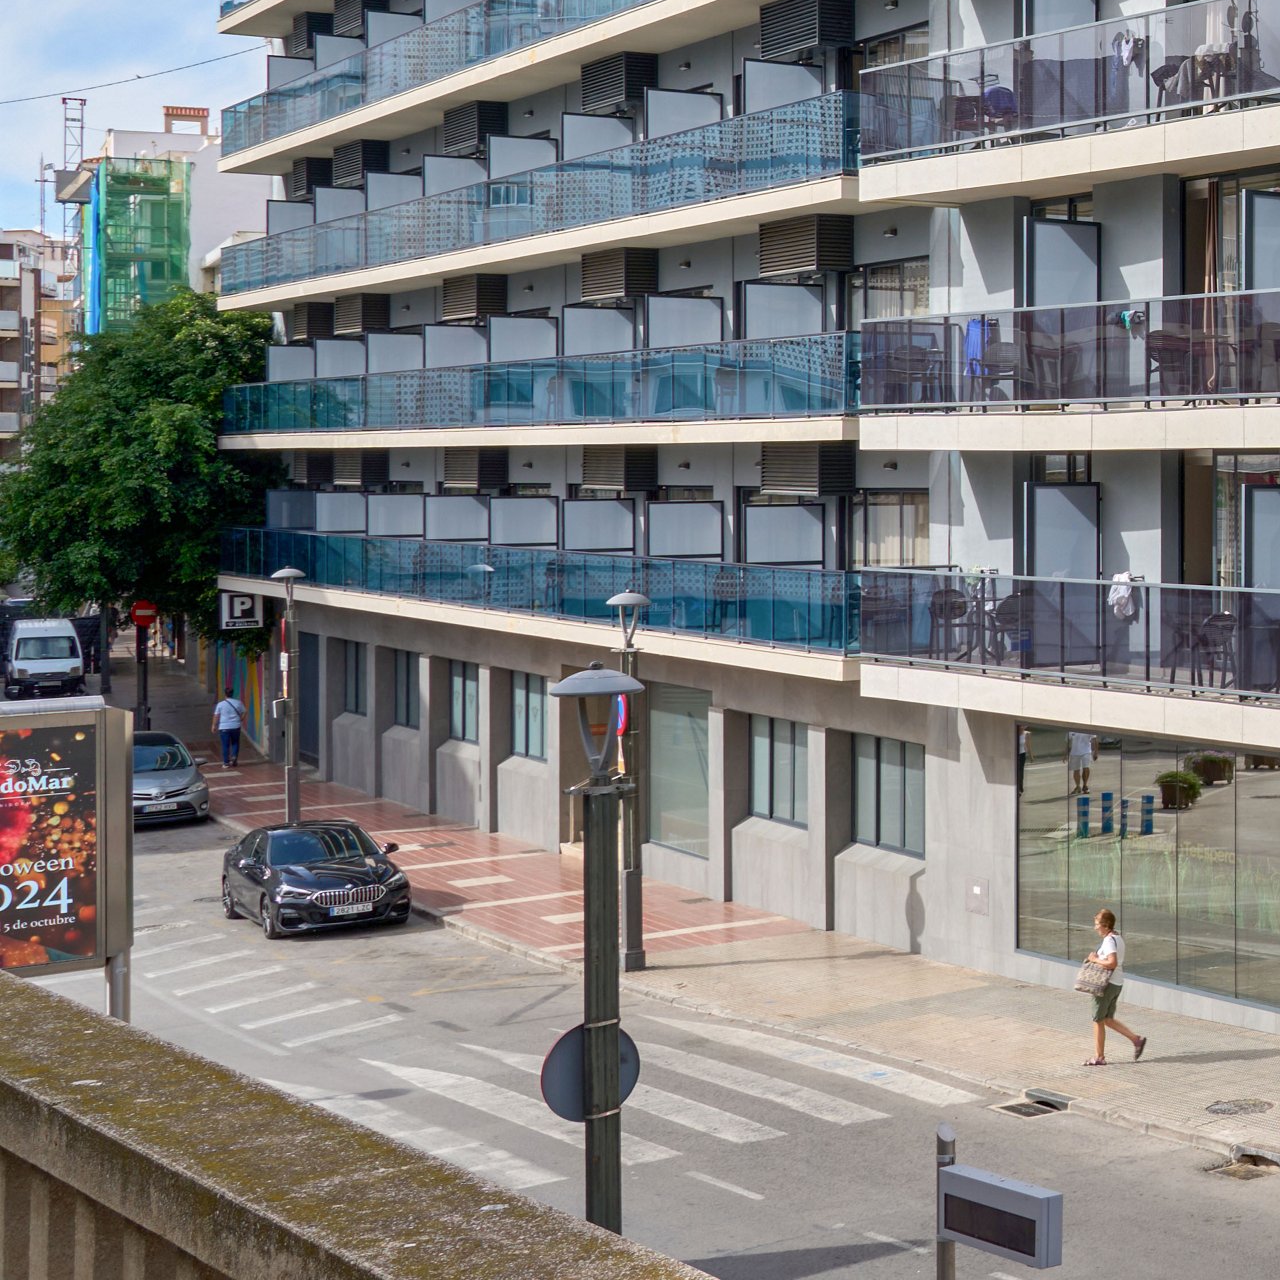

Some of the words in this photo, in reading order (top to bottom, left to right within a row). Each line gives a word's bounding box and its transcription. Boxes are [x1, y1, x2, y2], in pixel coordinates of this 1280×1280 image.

[233, 596, 253, 617] P
[12, 919, 28, 930] de
[30, 914, 76, 928] octubre
